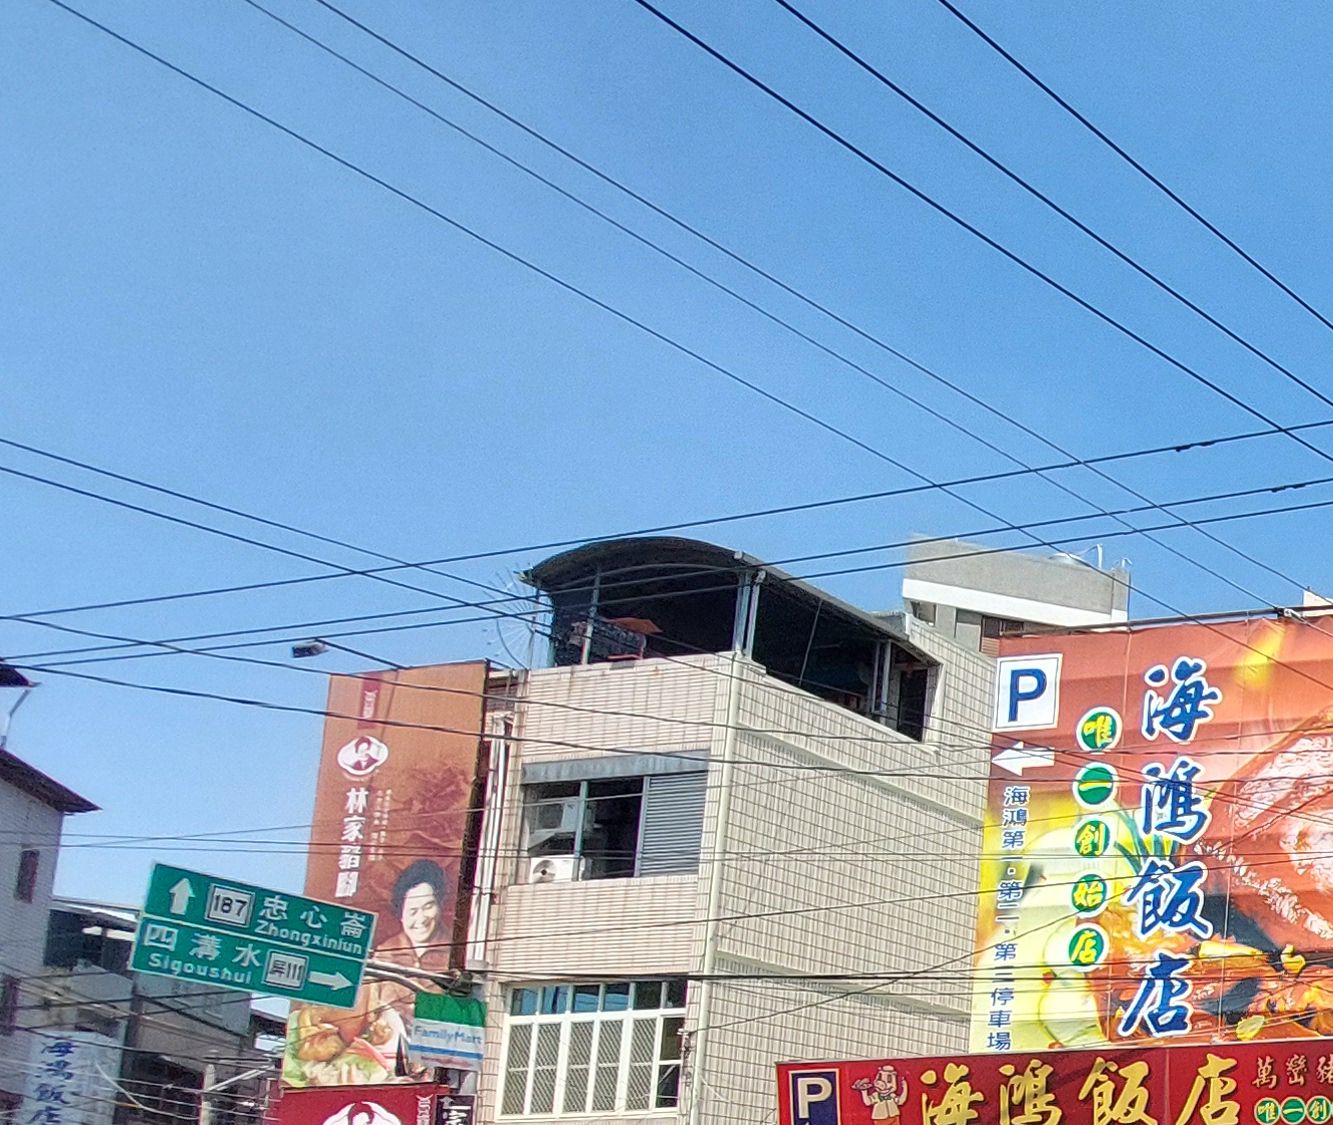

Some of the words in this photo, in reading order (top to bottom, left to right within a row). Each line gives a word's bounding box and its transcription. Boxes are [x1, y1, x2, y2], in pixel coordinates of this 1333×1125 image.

[1007, 667, 1047, 723] P
[1070, 714, 1114, 966] 唯一創始店
[1119, 657, 1222, 1039] 海鴻飯店
[213, 894, 248, 917] 187
[258, 895, 367, 939] 忠心崙
[143, 924, 262, 968] 四溝水
[254, 920, 363, 956] Zhongxinlun
[148, 953, 251, 985] Sigoushui
[414, 1026, 483, 1045] FamilyMart
[797, 1077, 833, 1119] P
